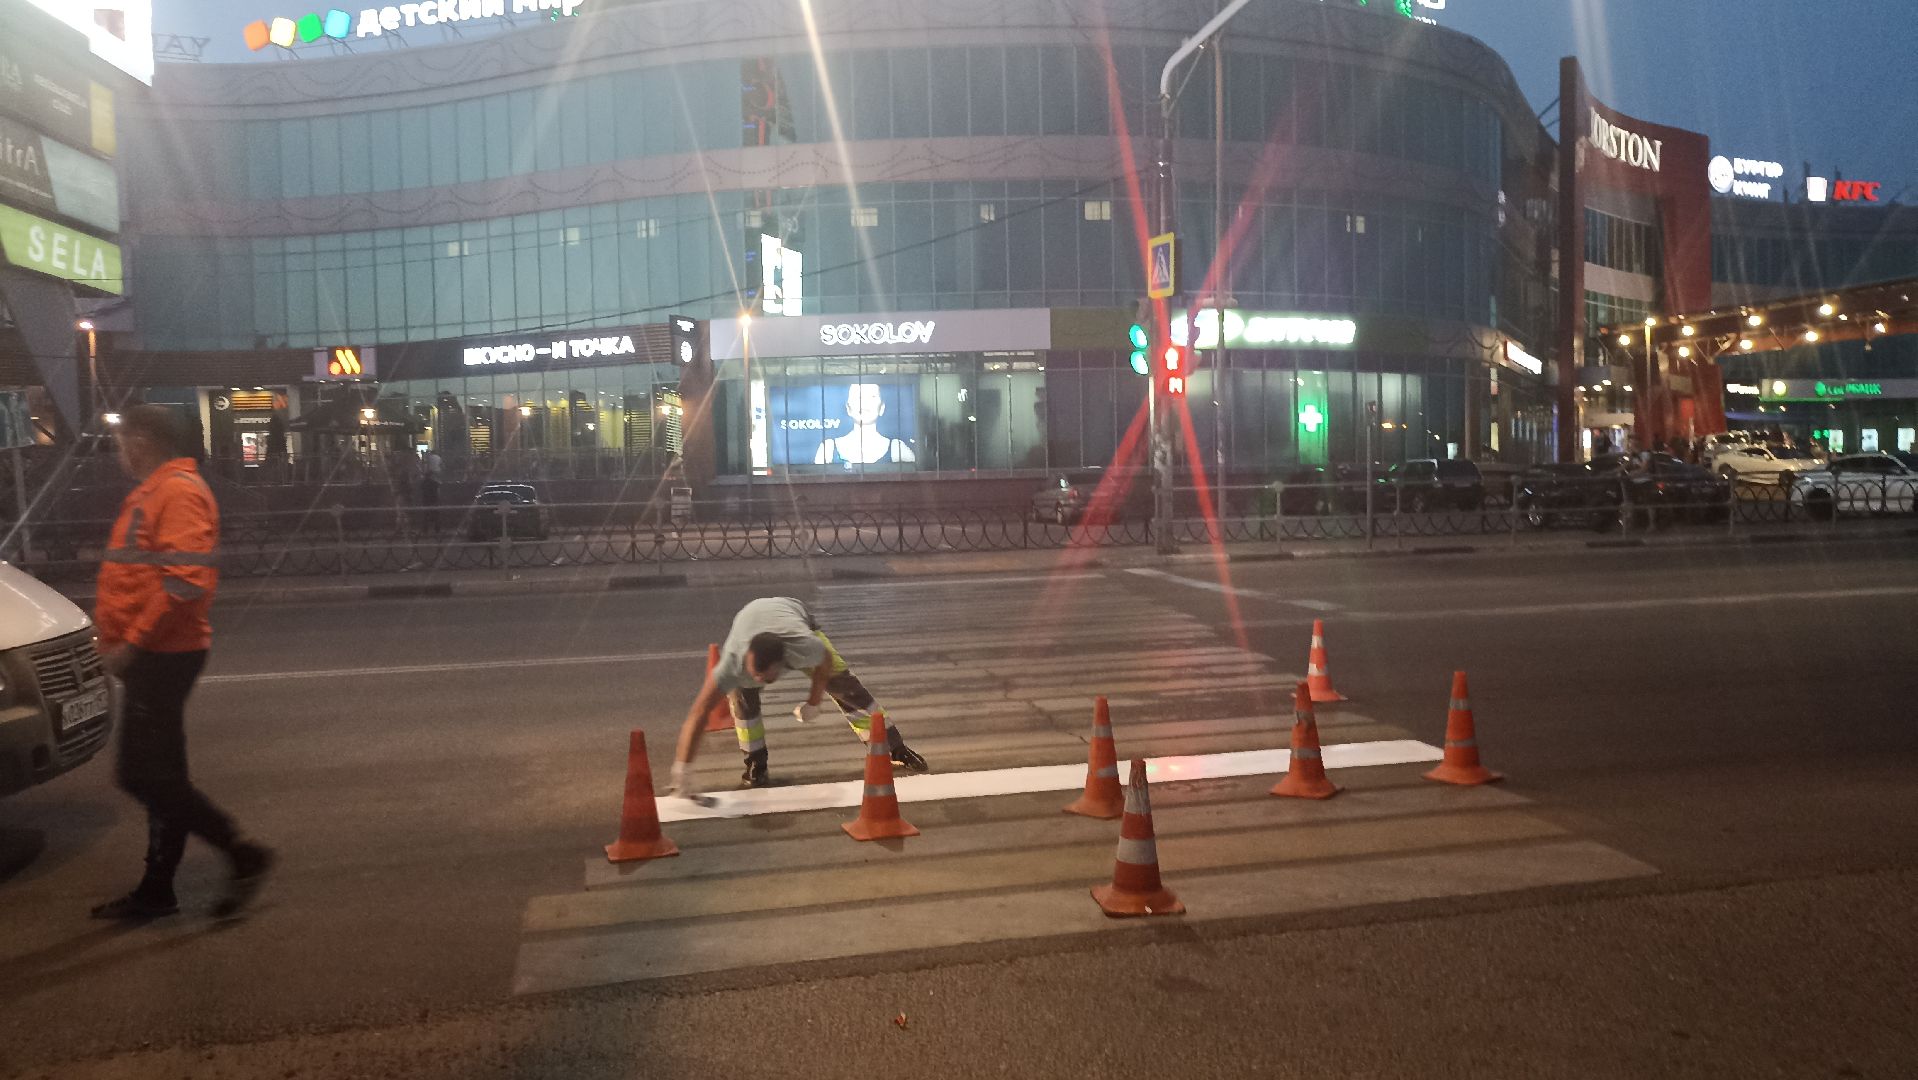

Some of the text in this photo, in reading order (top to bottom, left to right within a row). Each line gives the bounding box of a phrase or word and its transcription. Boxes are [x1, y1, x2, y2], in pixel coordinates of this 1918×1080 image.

[1833, 181, 1881, 201] KFC
[28, 225, 107, 282] SELA
[820, 321, 936, 345] SOKOLOV
[569, 335, 636, 359] ТОЧКА
[780, 418, 841, 430] SOKOLOV
